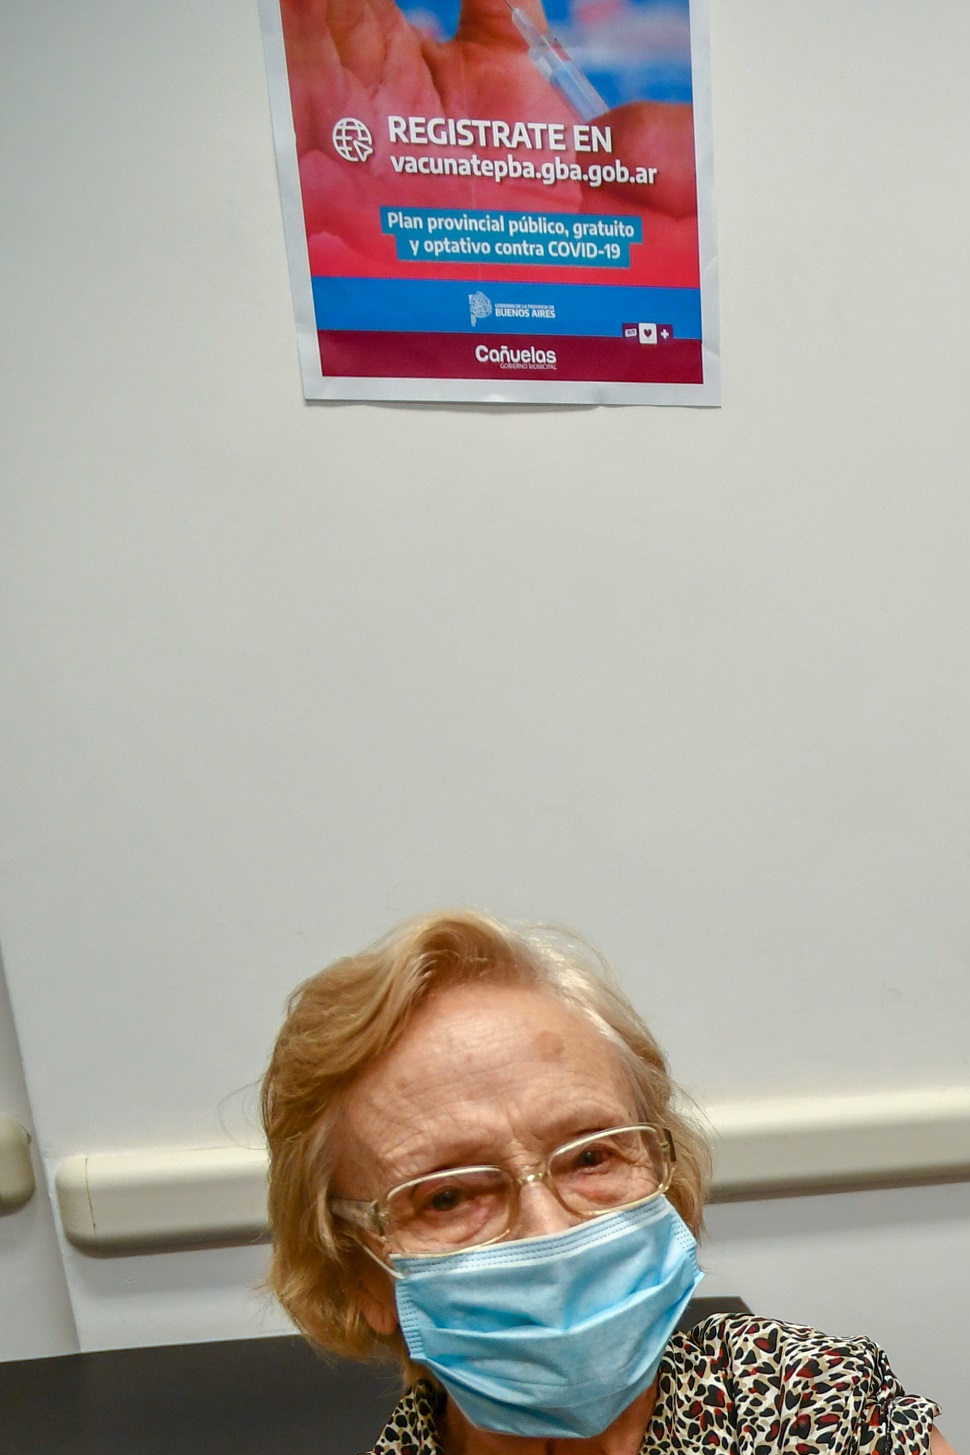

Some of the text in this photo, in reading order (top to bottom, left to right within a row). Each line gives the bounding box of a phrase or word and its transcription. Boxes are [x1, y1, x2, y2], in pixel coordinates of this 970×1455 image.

[387, 115, 613, 153] REGISTRATE EN
[389, 153, 658, 188] vacunatepba.gba.gob.ar
[387, 211, 635, 240] Plan provincial público, gratuito
[408, 237, 621, 260] y optativo contra COVID-19
[495, 308, 556, 318] BUENOS AIRES
[474, 344, 557, 364] Cañuelas
